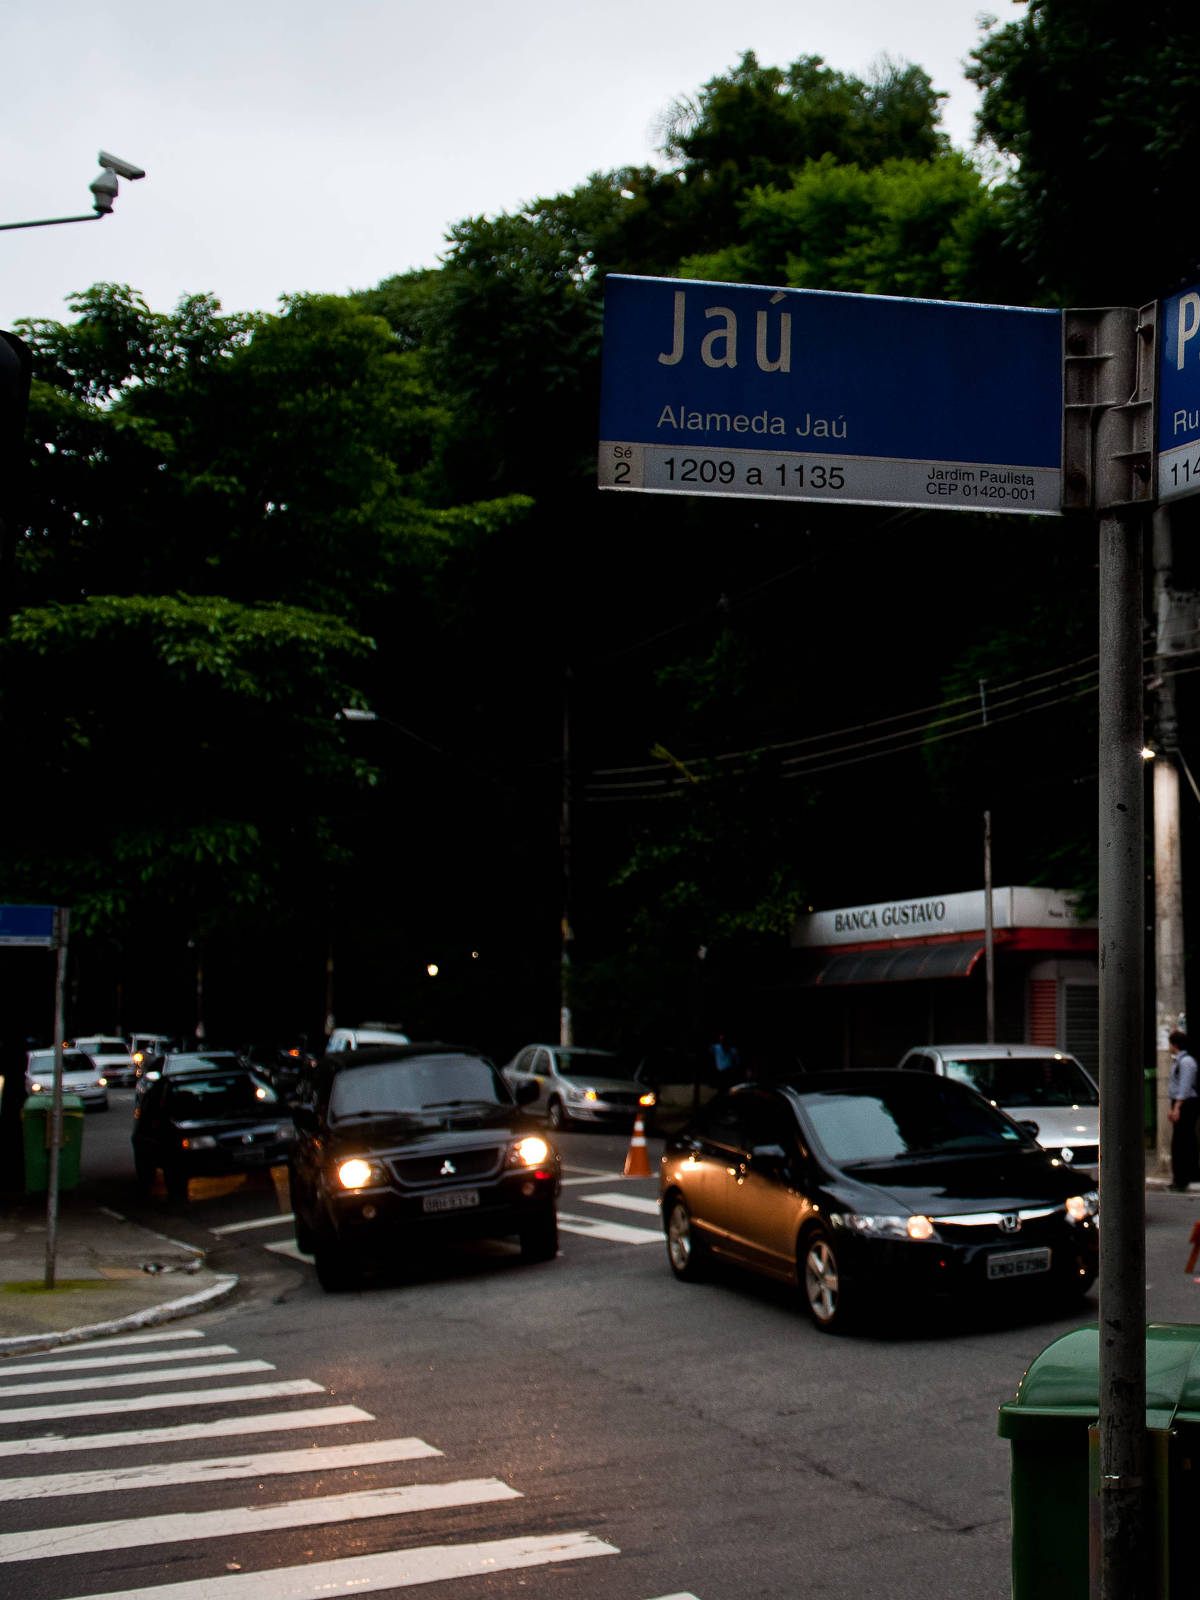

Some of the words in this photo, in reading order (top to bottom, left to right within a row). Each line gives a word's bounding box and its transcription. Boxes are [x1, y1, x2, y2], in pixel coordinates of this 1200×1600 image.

[657, 290, 791, 373] Jaú
[657, 405, 786, 436] Alameda
[795, 412, 847, 439] Jaú
[613, 446, 632, 459] Sé
[614, 463, 631, 484] 2
[664, 457, 736, 485] 1209
[746, 467, 763, 486] a
[775, 463, 846, 490] 1135
[927, 467, 976, 482] Jardim
[979, 470, 1034, 486] Paulista
[926, 481, 959, 496] CEP
[962, 483, 1036, 500] 01420-001
[835, 910, 878, 932] BANCA
[882, 901, 945, 927] GUSTAVO
